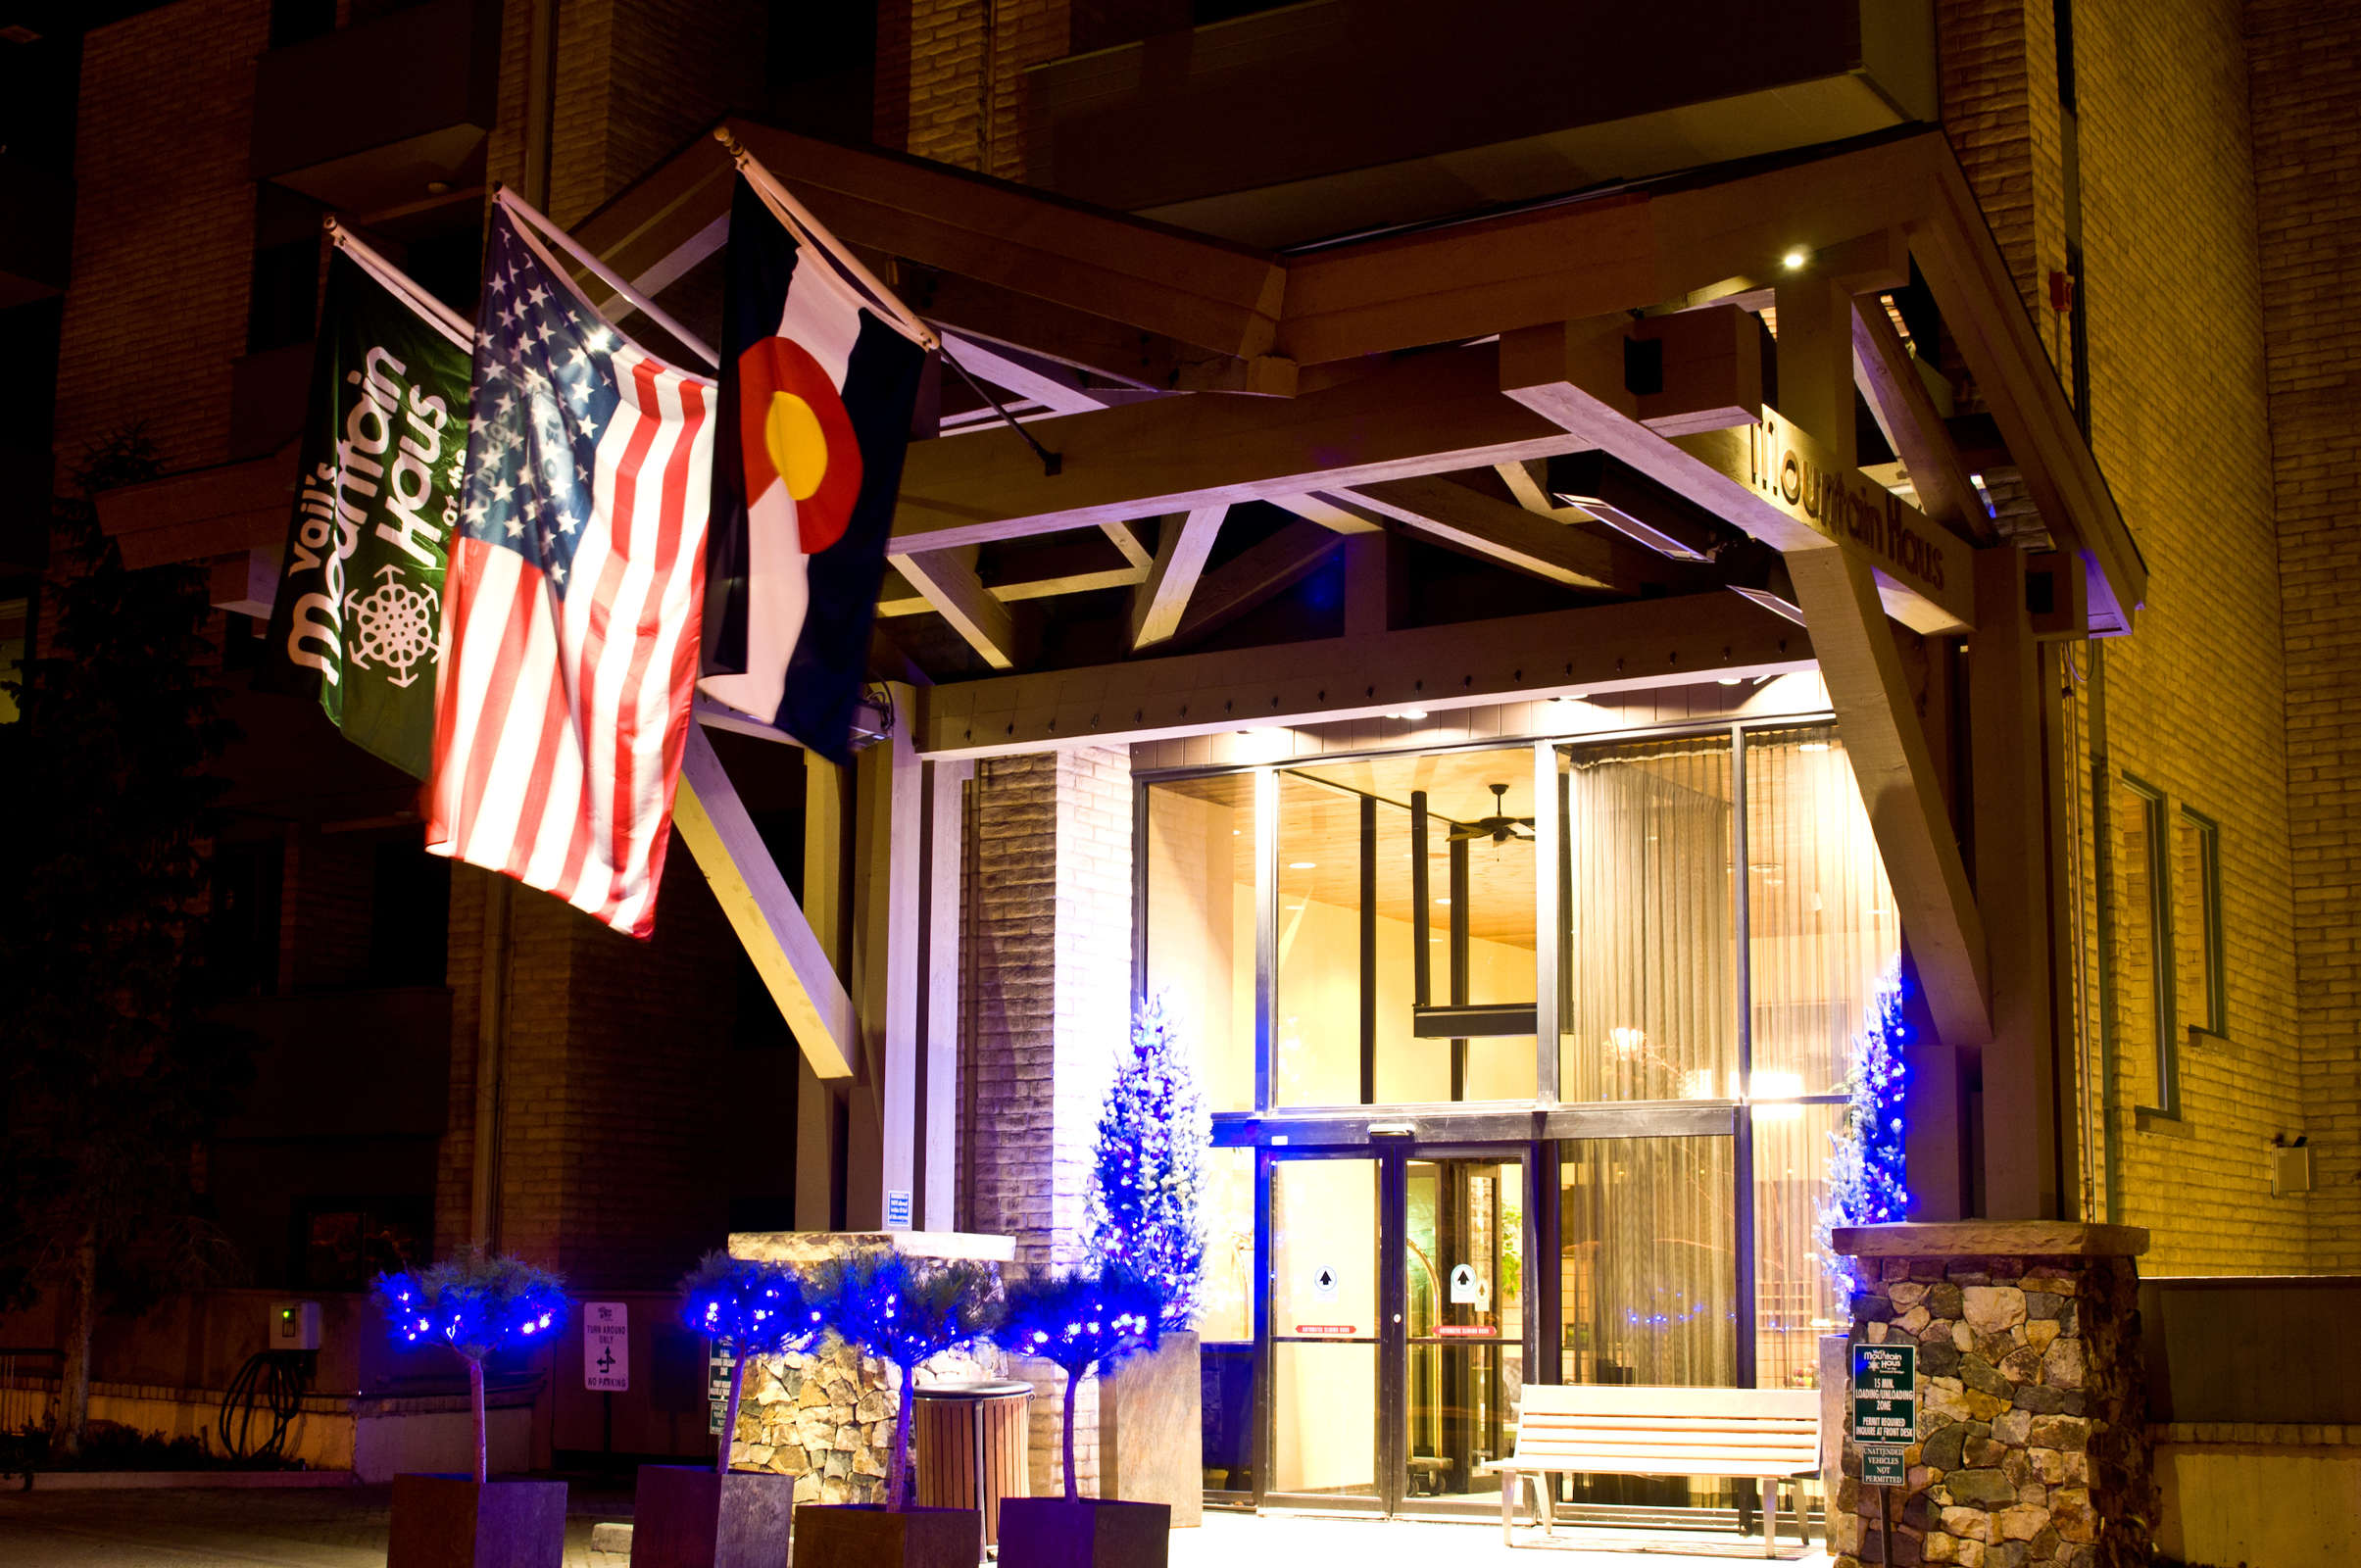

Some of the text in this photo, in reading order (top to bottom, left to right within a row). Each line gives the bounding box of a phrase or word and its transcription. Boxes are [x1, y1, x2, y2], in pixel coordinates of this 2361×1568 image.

[375, 385, 447, 567] Haus
[1886, 490, 1945, 591] Haus
[587, 1325, 626, 1335] TURN AROUND
[599, 1336, 614, 1345] ONLY
[588, 1378, 626, 1388] NO PARKING
[1874, 1378, 1881, 1389] 15
[1876, 1399, 1892, 1411] ZONE
[1862, 1416, 1905, 1427] PERMIT REQUIRED
[1877, 1427, 1883, 1436] AT
[1883, 1427, 1899, 1437] FRONT
[1899, 1428, 1913, 1437] DESK
[1865, 1475, 1902, 1484] PERMITTED
